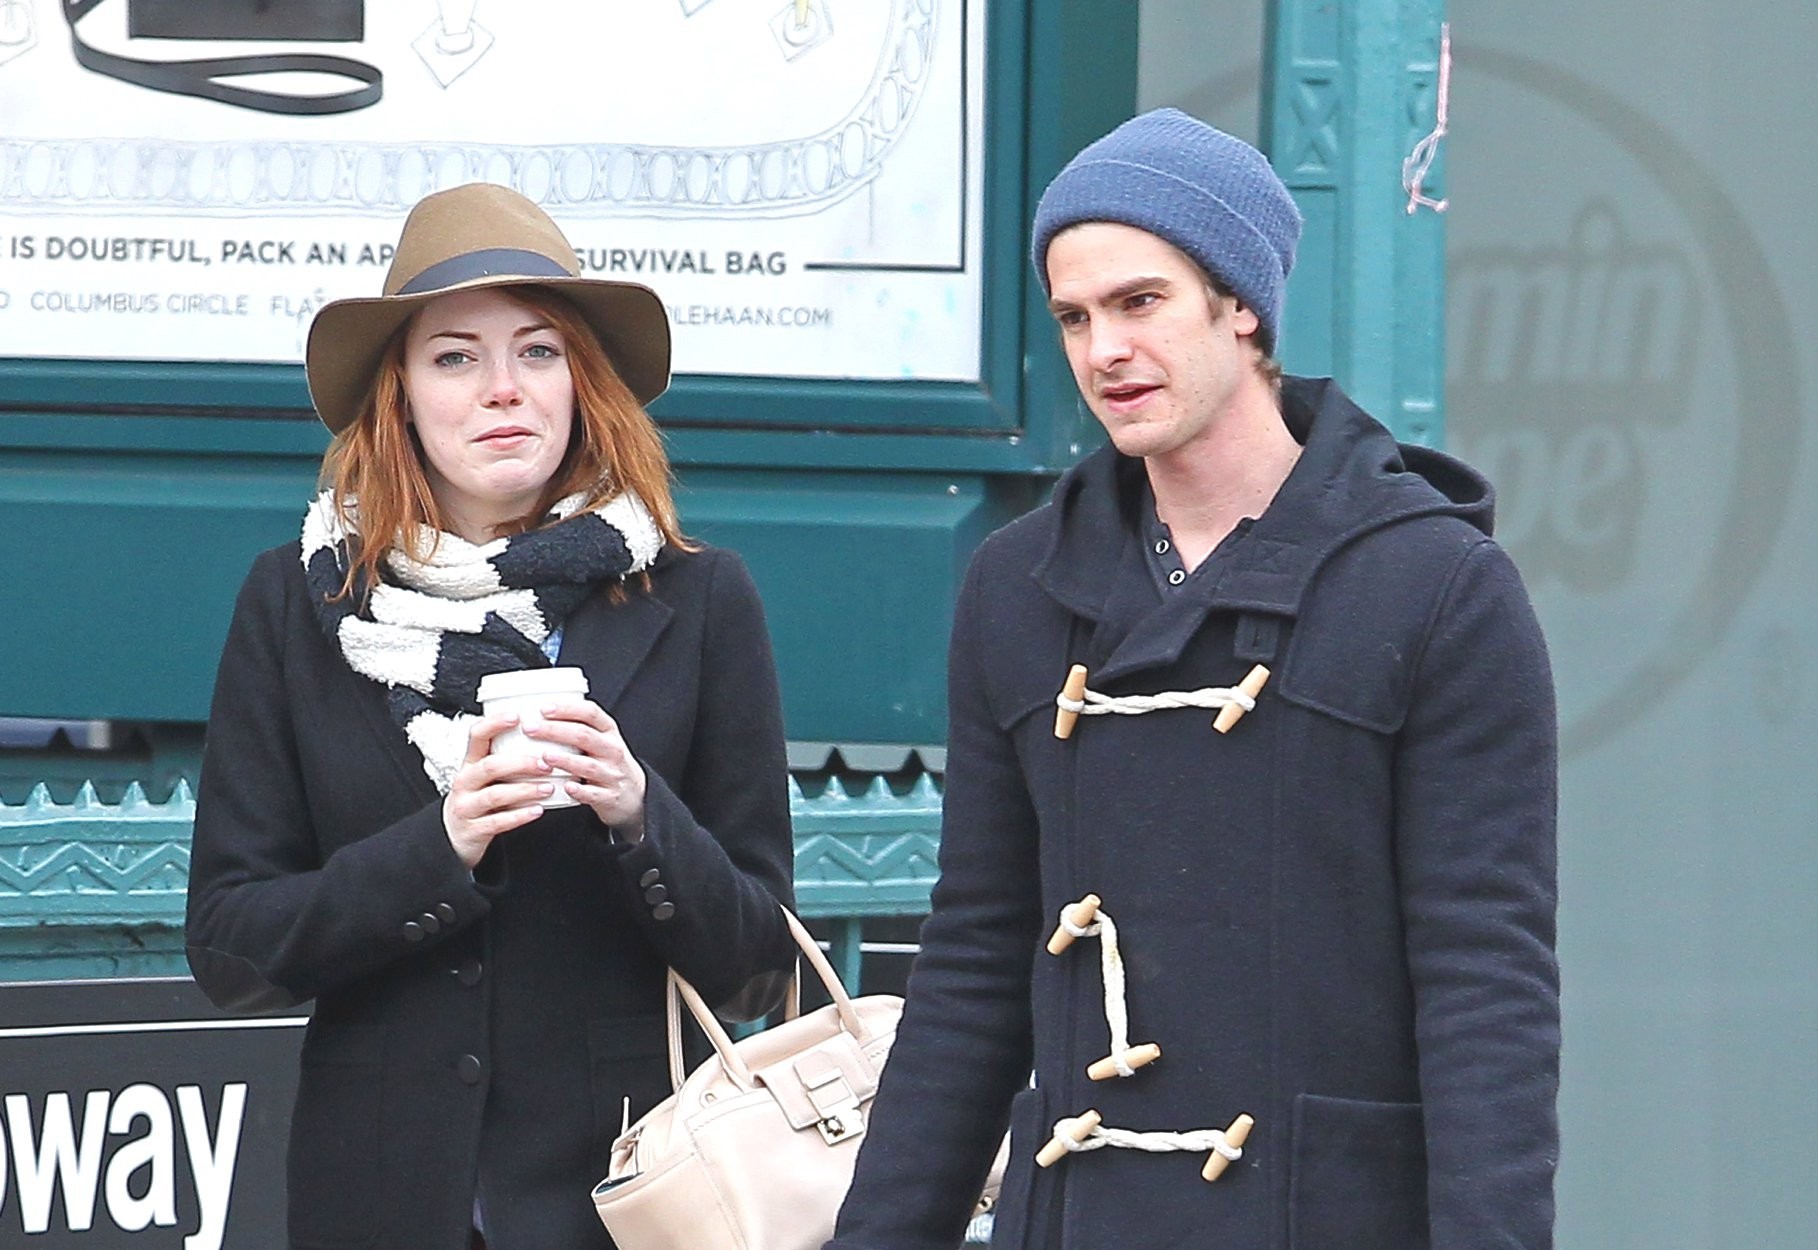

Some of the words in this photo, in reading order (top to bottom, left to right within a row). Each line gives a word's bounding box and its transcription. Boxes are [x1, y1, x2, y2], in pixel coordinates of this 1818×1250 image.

[11, 236, 35, 259] IS
[45, 236, 211, 266] DOUBTFUL,
[221, 239, 295, 264] PACK
[305, 242, 346, 265] AN
[725, 251, 787, 275] BAG
[31, 290, 157, 314] COLUMBUS
[167, 293, 248, 316] CIRCLE
